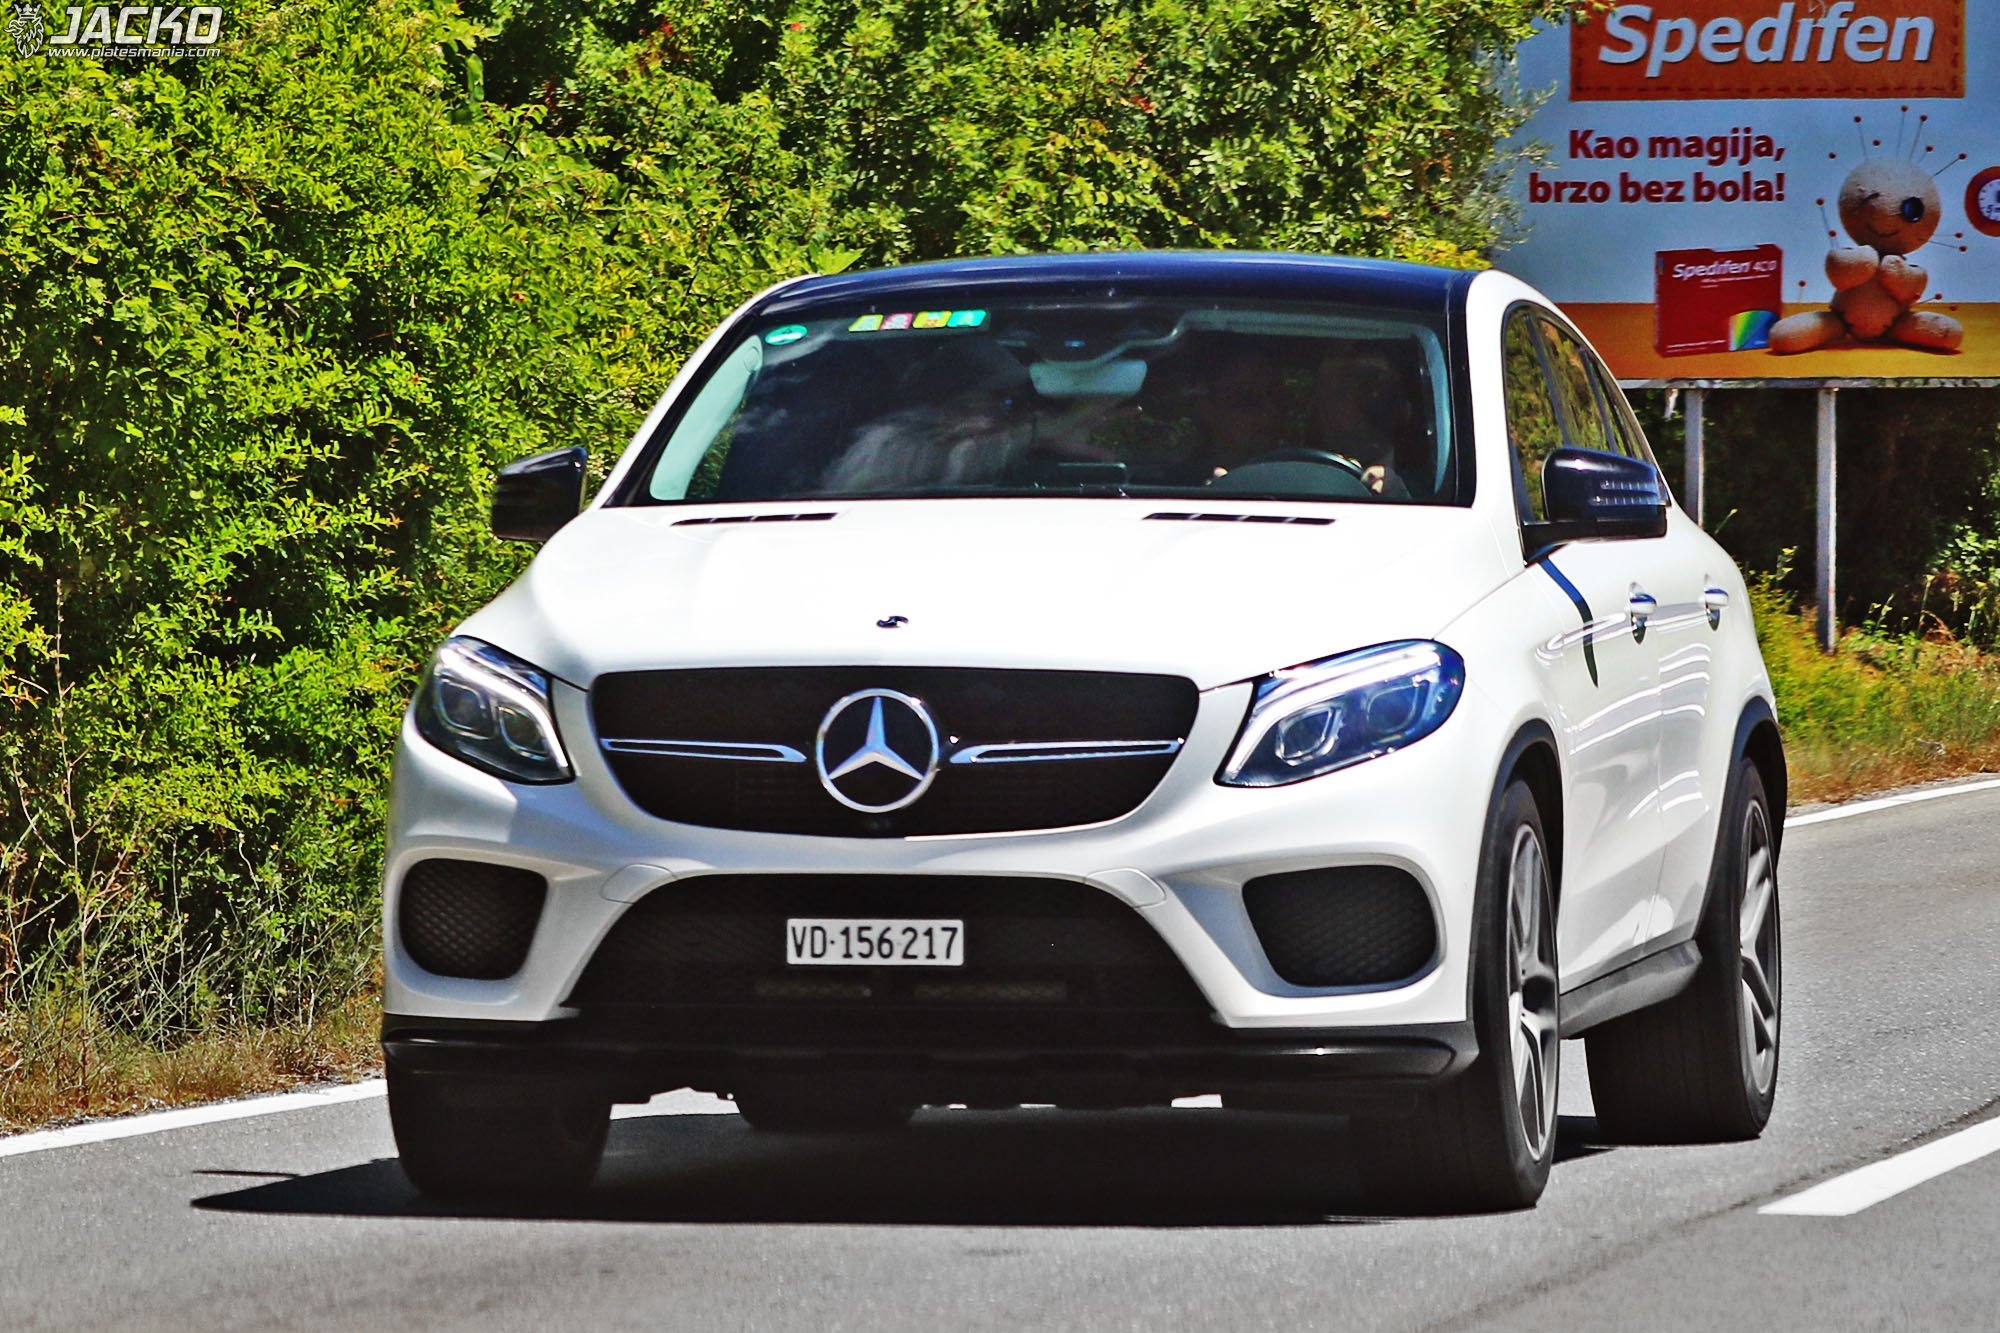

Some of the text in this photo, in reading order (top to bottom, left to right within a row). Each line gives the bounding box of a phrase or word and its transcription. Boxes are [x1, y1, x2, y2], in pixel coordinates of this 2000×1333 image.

[1598, 1, 1936, 77] Spedifen
[1568, 127, 1786, 166] Kao magija,
[1528, 171, 1786, 203] brzo bez bola!
[1672, 260, 1751, 281] Spedifen
